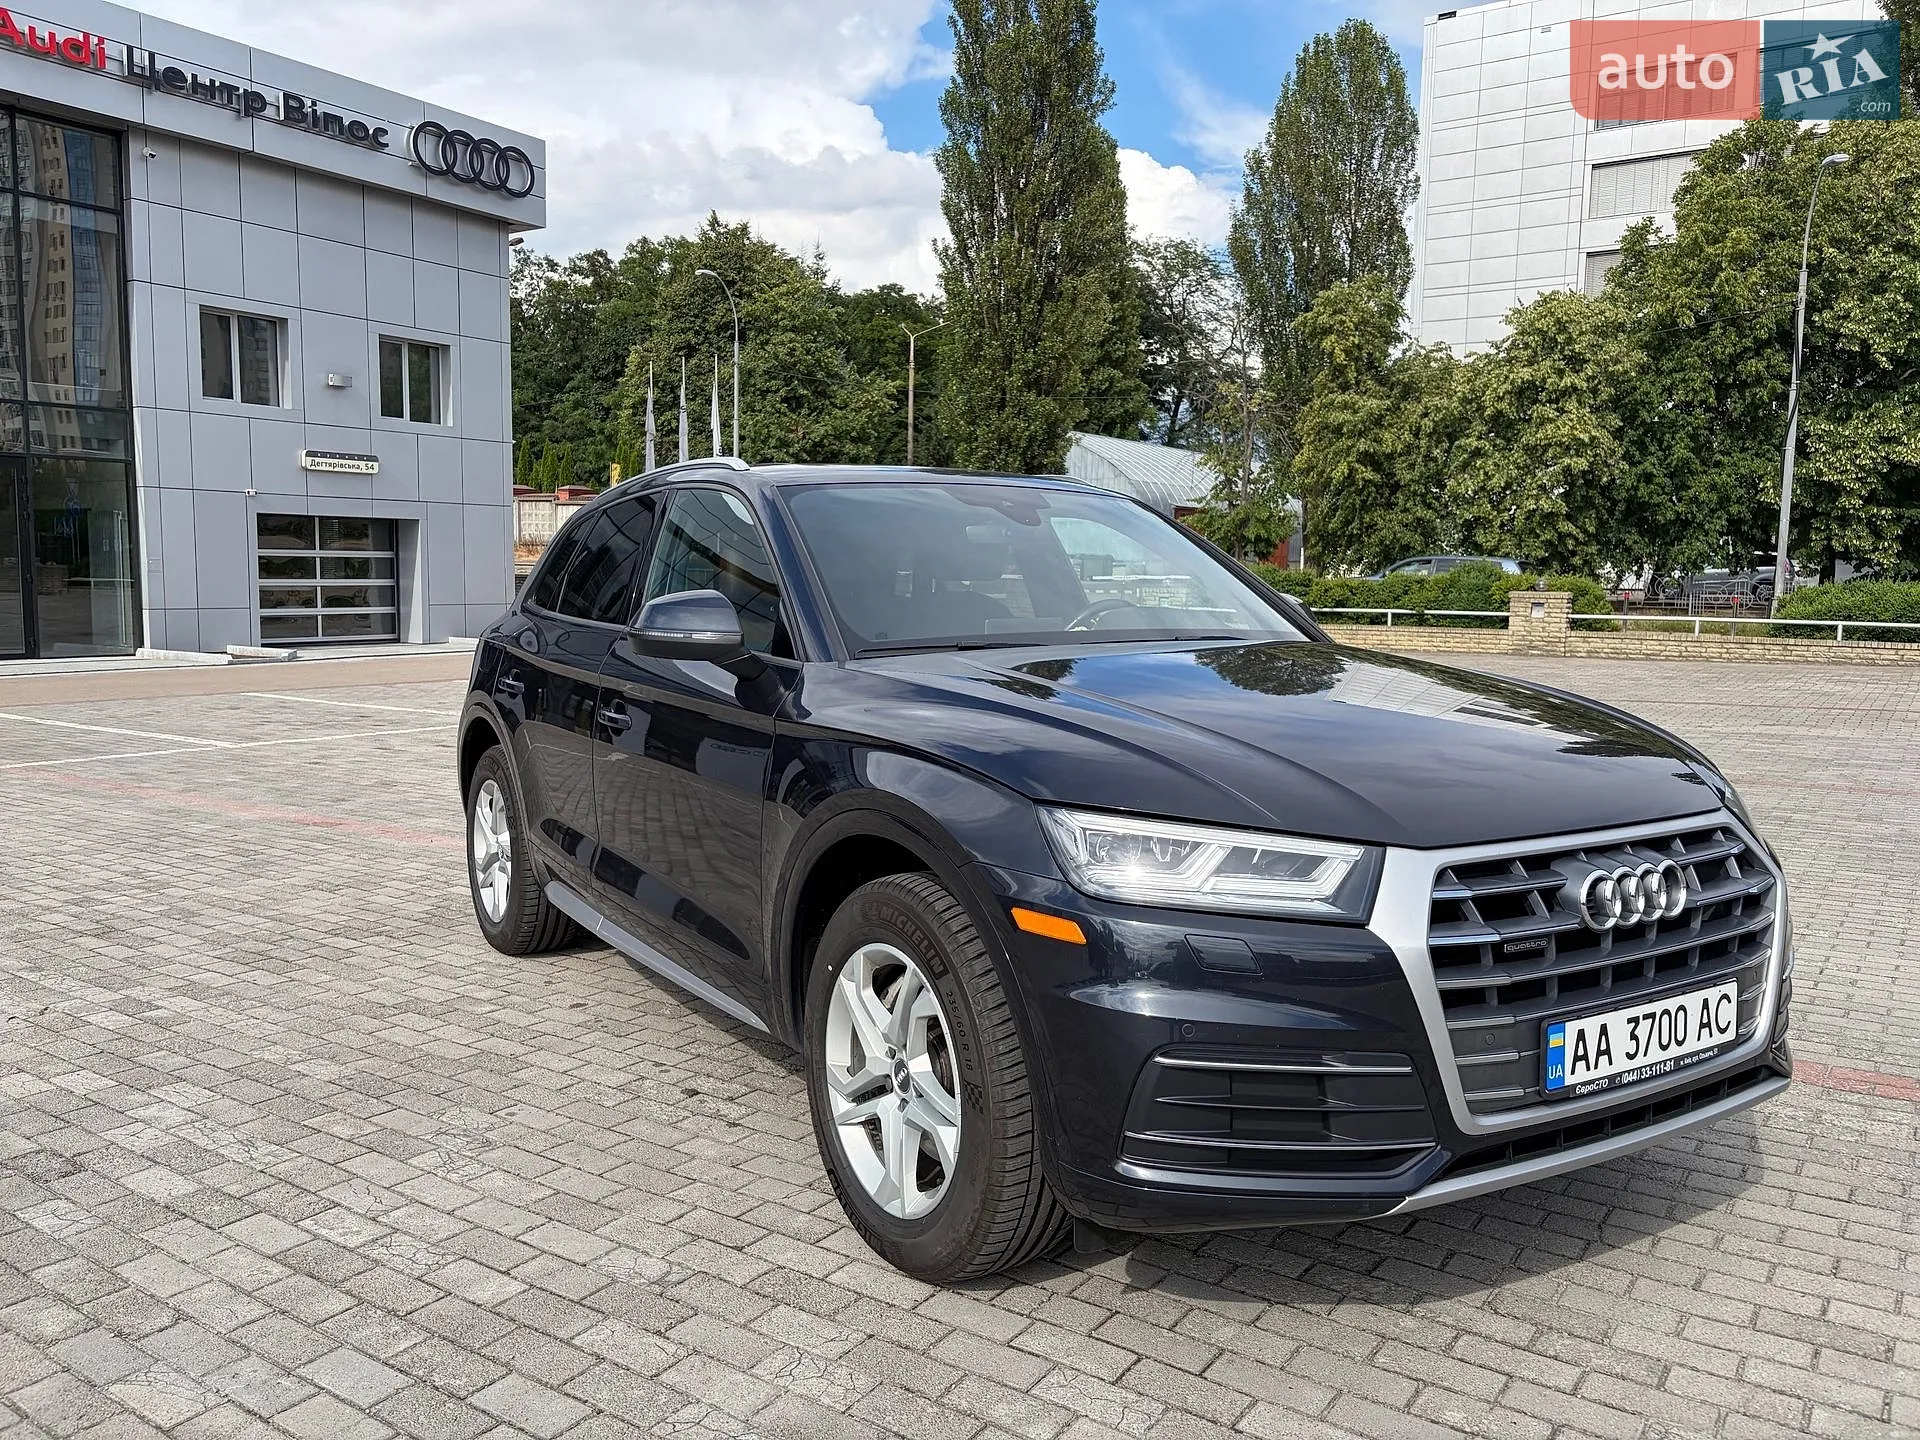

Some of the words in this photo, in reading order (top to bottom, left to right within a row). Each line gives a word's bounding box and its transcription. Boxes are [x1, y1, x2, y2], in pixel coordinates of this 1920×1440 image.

[0, 6, 107, 70] Audi
[124, 45, 267, 118] Центр
[280, 91, 389, 149] Віпос
[309, 459, 363, 471] Дегтярівська,
[365, 463, 375, 471] 54
[880, 904, 944, 974] MICHELIN
[1506, 940, 1547, 951] quattro
[945, 991, 966, 1038] 235/60
[961, 1043, 971, 1052] R
[1570, 1023, 1613, 1075] AA
[1625, 1004, 1688, 1060] 3700
[1697, 993, 1732, 1042] AC
[1548, 1064, 1563, 1079] UA
[1621, 1071, 1640, 1084] (044)
[1641, 1060, 1674, 1079] 33-111-81
